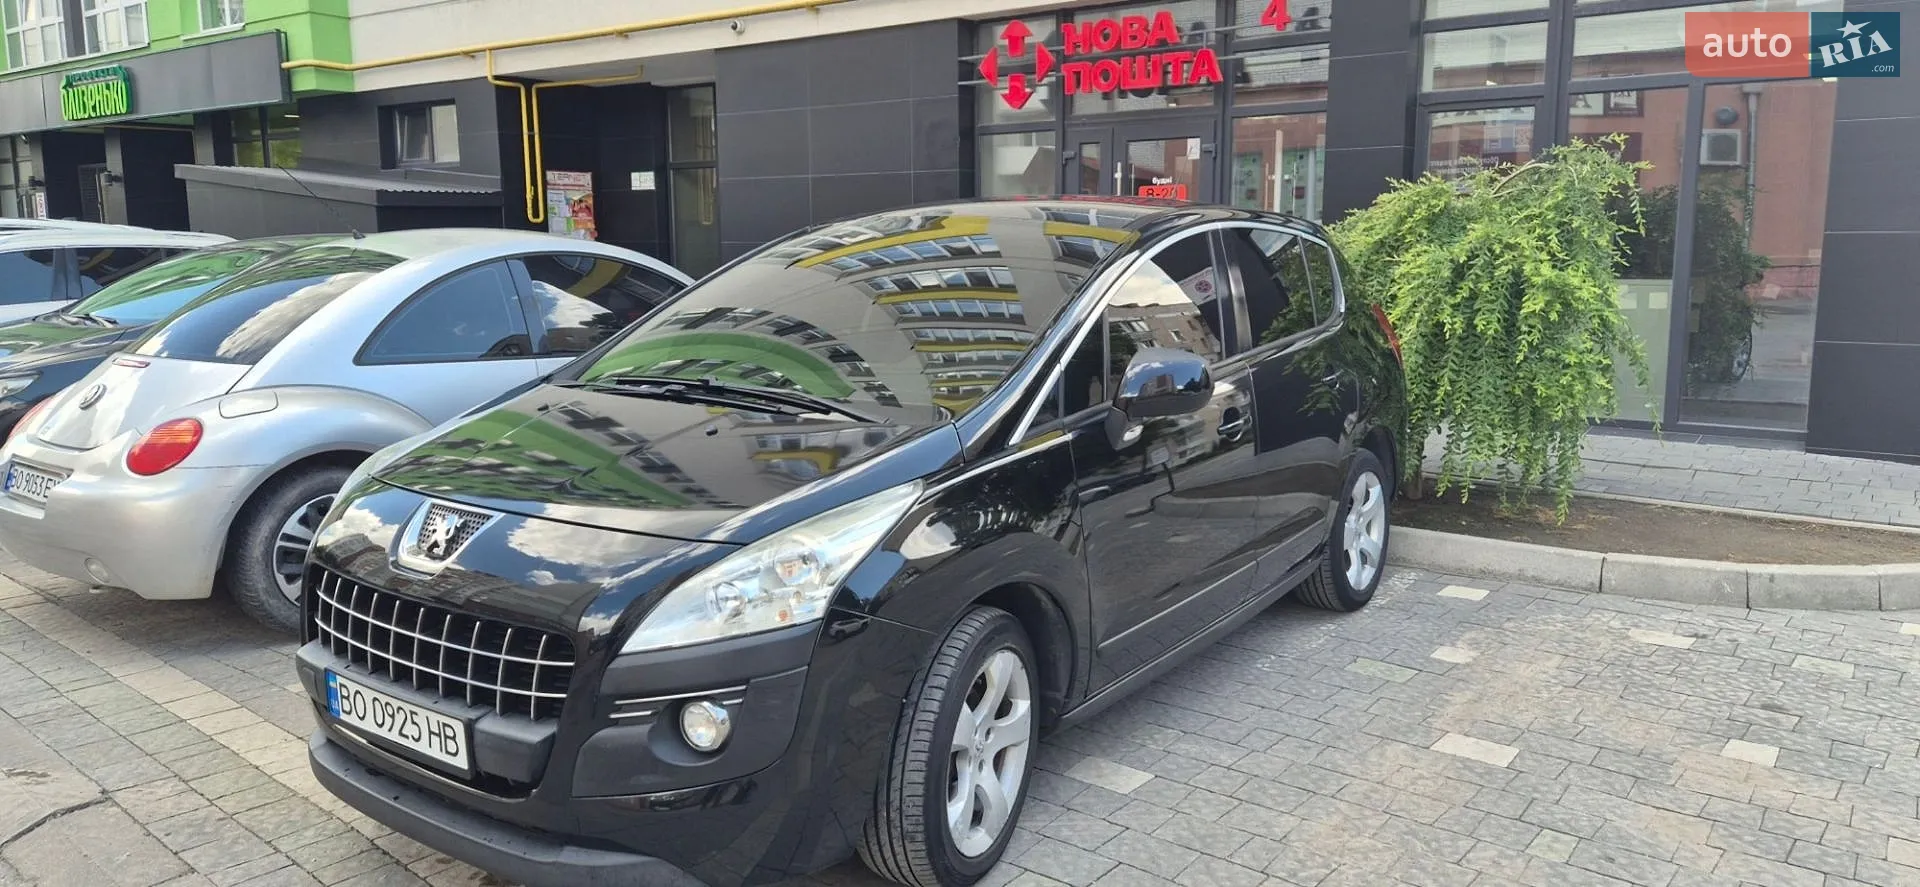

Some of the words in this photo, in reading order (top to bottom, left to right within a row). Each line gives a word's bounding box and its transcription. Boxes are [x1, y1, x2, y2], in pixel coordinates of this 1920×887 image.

[1061, 11, 1180, 55] НОВА
[1260, 0, 1292, 31] 4
[1062, 49, 1223, 95] ПОШТА
[23, 472, 46, 497] 9053
[339, 682, 367, 722] BO
[372, 696, 422, 743] 0925
[426, 715, 459, 757] HB
